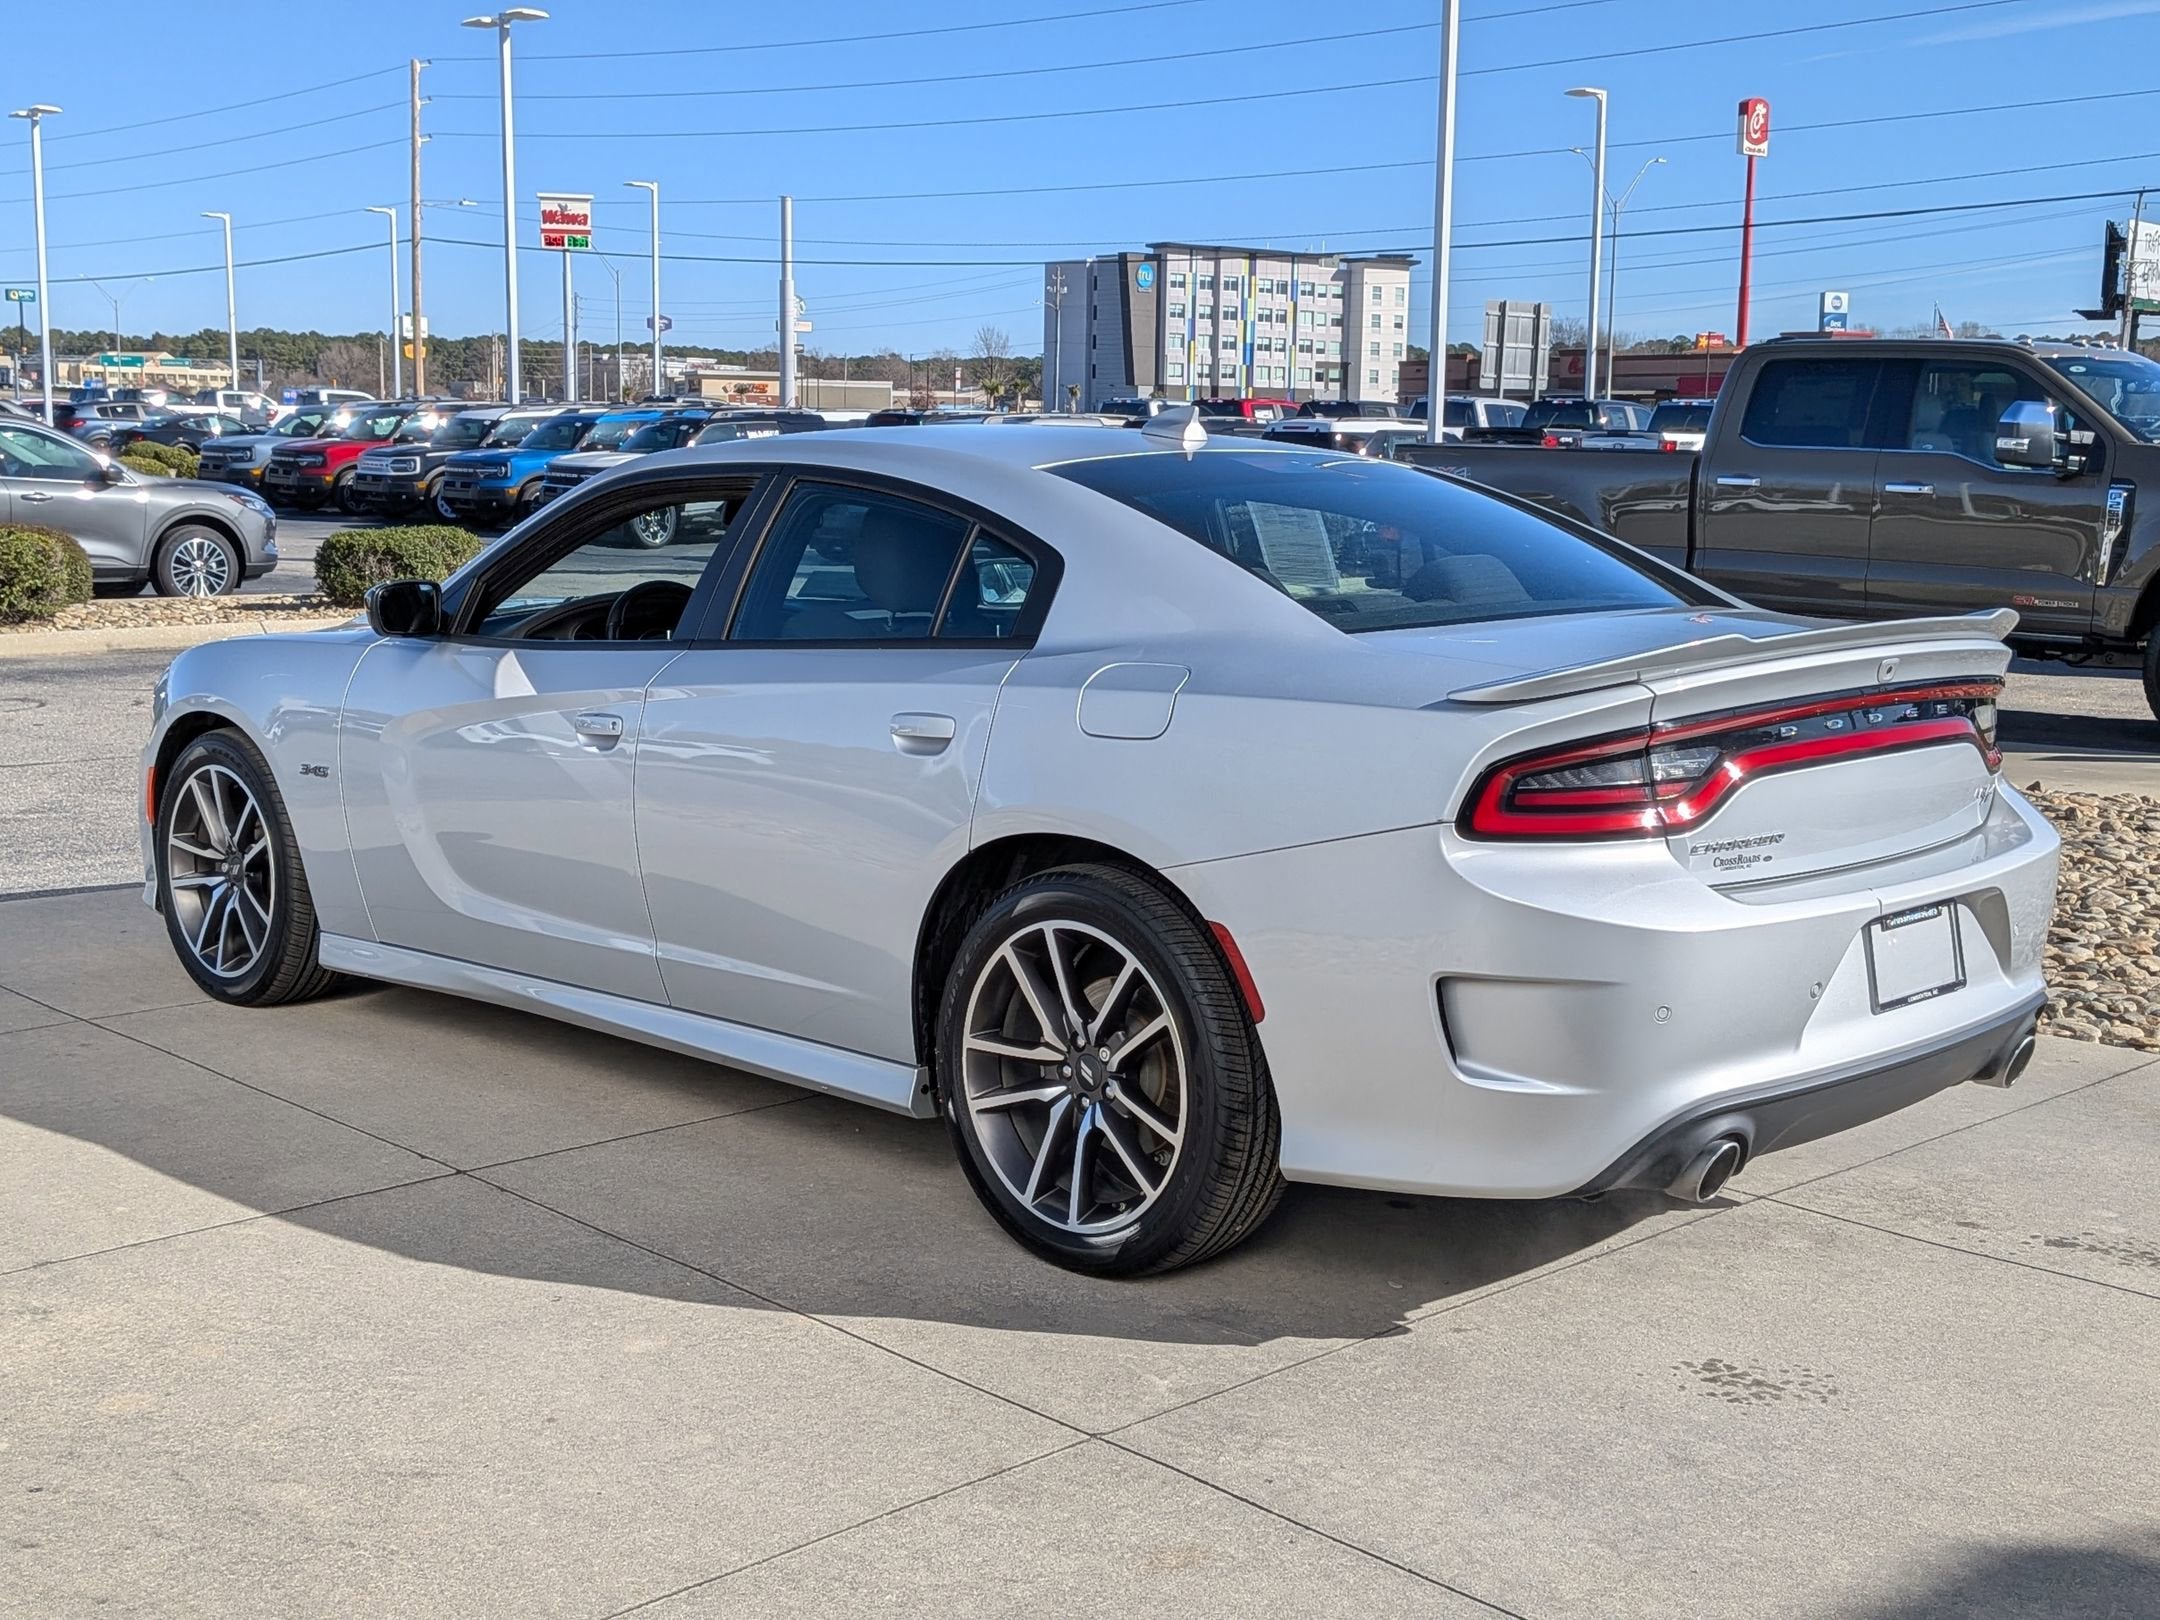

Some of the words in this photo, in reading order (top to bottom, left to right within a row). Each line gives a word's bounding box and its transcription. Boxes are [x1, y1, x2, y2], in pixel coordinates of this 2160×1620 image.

[541, 209, 589, 226] Wawa
[1779, 703, 1949, 738] DODGE
[299, 763, 330, 778] 345
[1689, 832, 1786, 857] CHARGER
